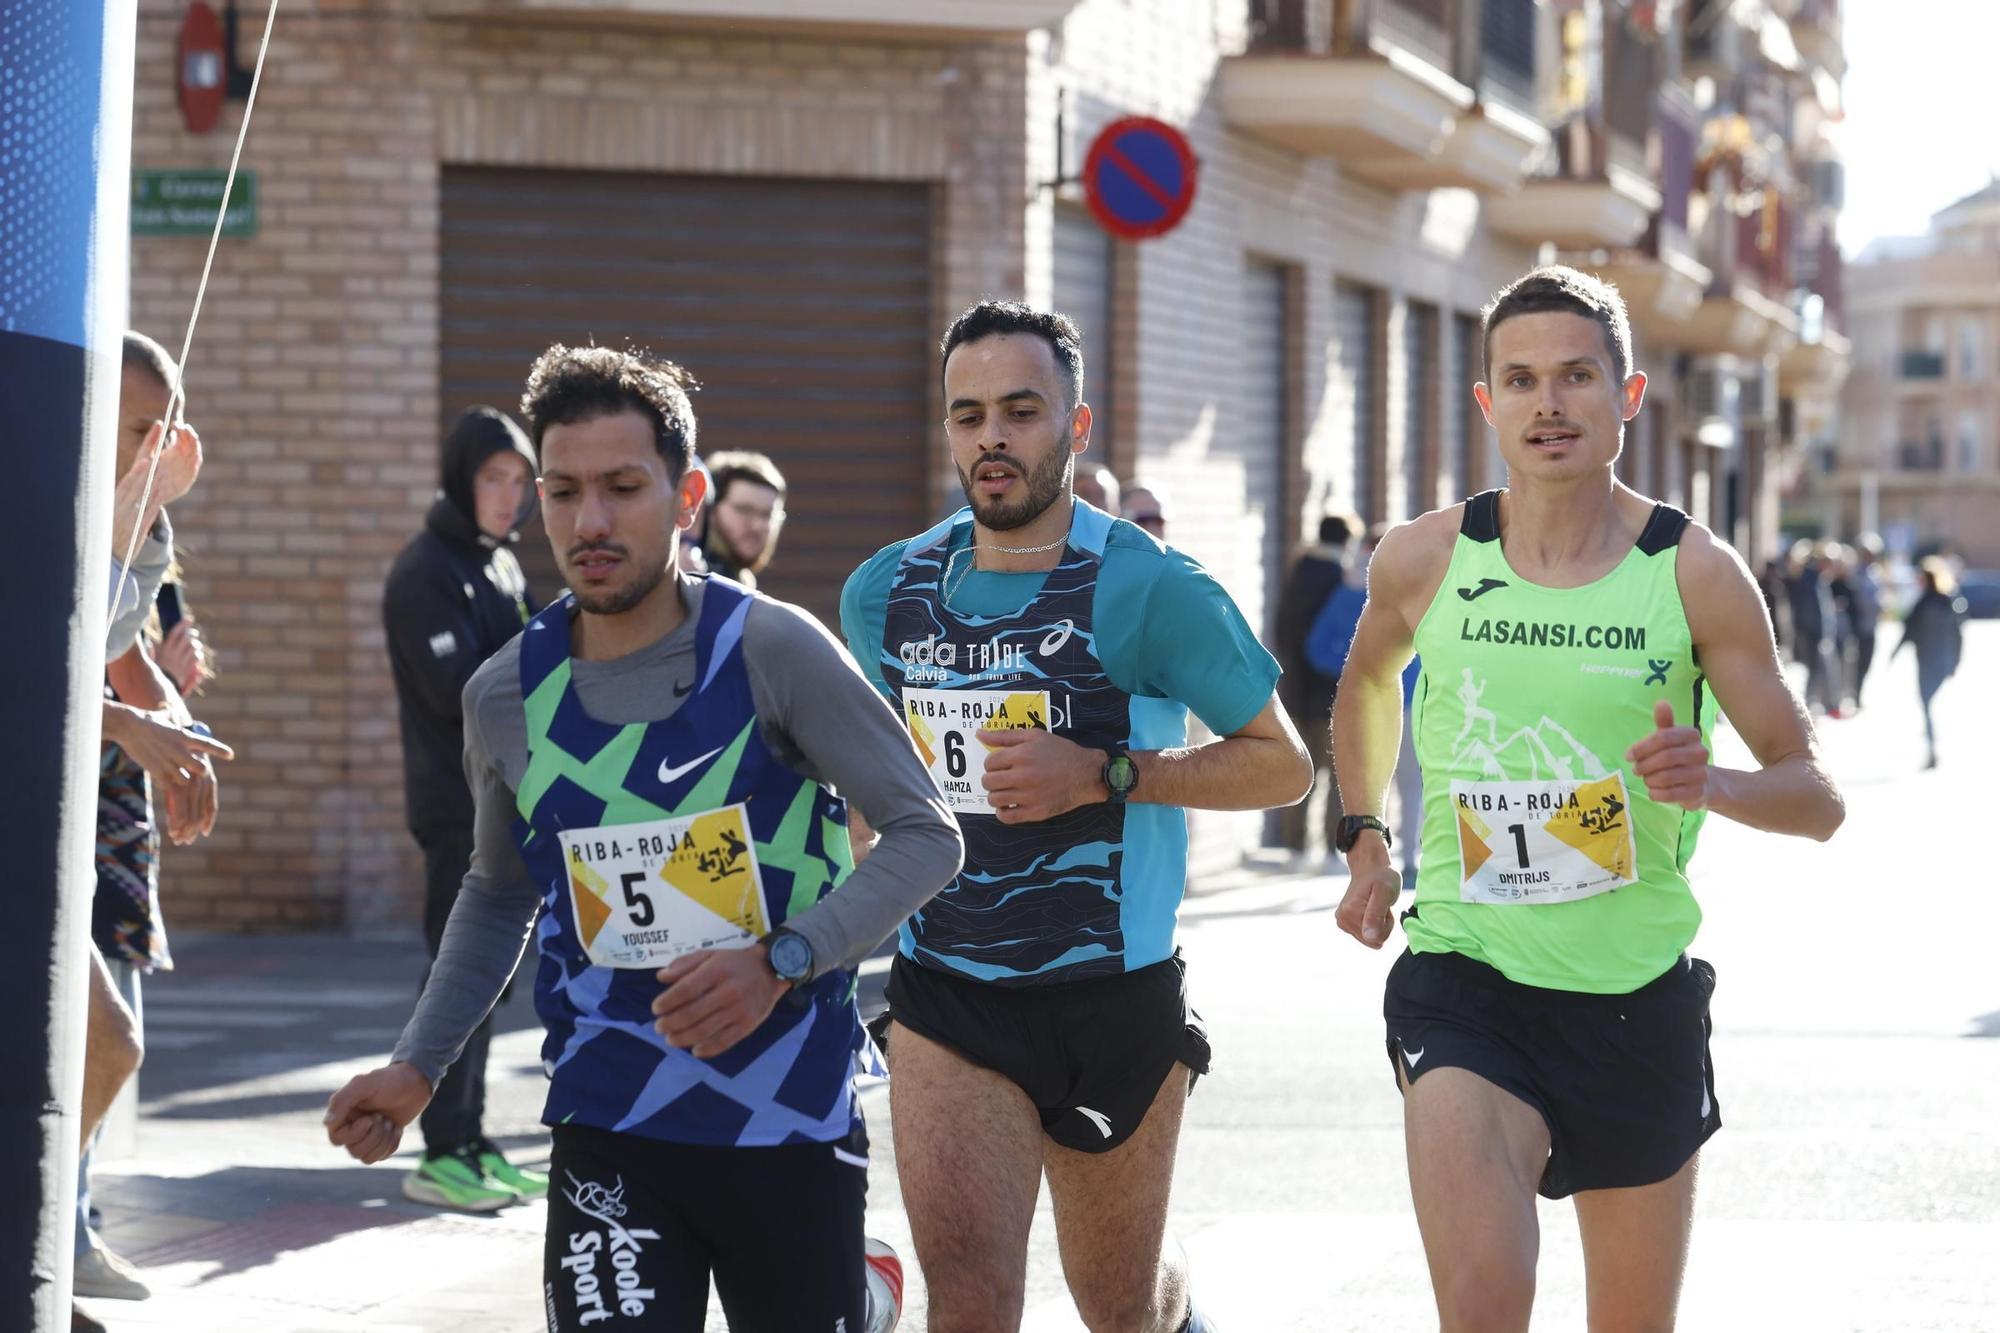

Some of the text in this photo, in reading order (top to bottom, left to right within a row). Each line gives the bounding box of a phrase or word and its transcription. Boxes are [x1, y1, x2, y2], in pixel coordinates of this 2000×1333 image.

[1460, 617, 1646, 650] LASANSI.COM
[967, 637, 1025, 671] TRIBE
[906, 666, 947, 681] Calvià
[910, 699, 1009, 719] RIBA-ROJA
[962, 721, 973, 729] DE
[944, 730, 967, 778] 6
[944, 780, 972, 793] HAMZA
[1458, 791, 1580, 811] RIBA-ROJA
[571, 831, 697, 863] RIBA-ROJA
[1508, 823, 1531, 869] 1
[1498, 870, 1551, 886] DMITRIJS
[620, 871, 655, 928] 5
[621, 929, 670, 947] YOUSSEF
[561, 1230, 615, 1326] Sport
[608, 1226, 661, 1317] Koole
